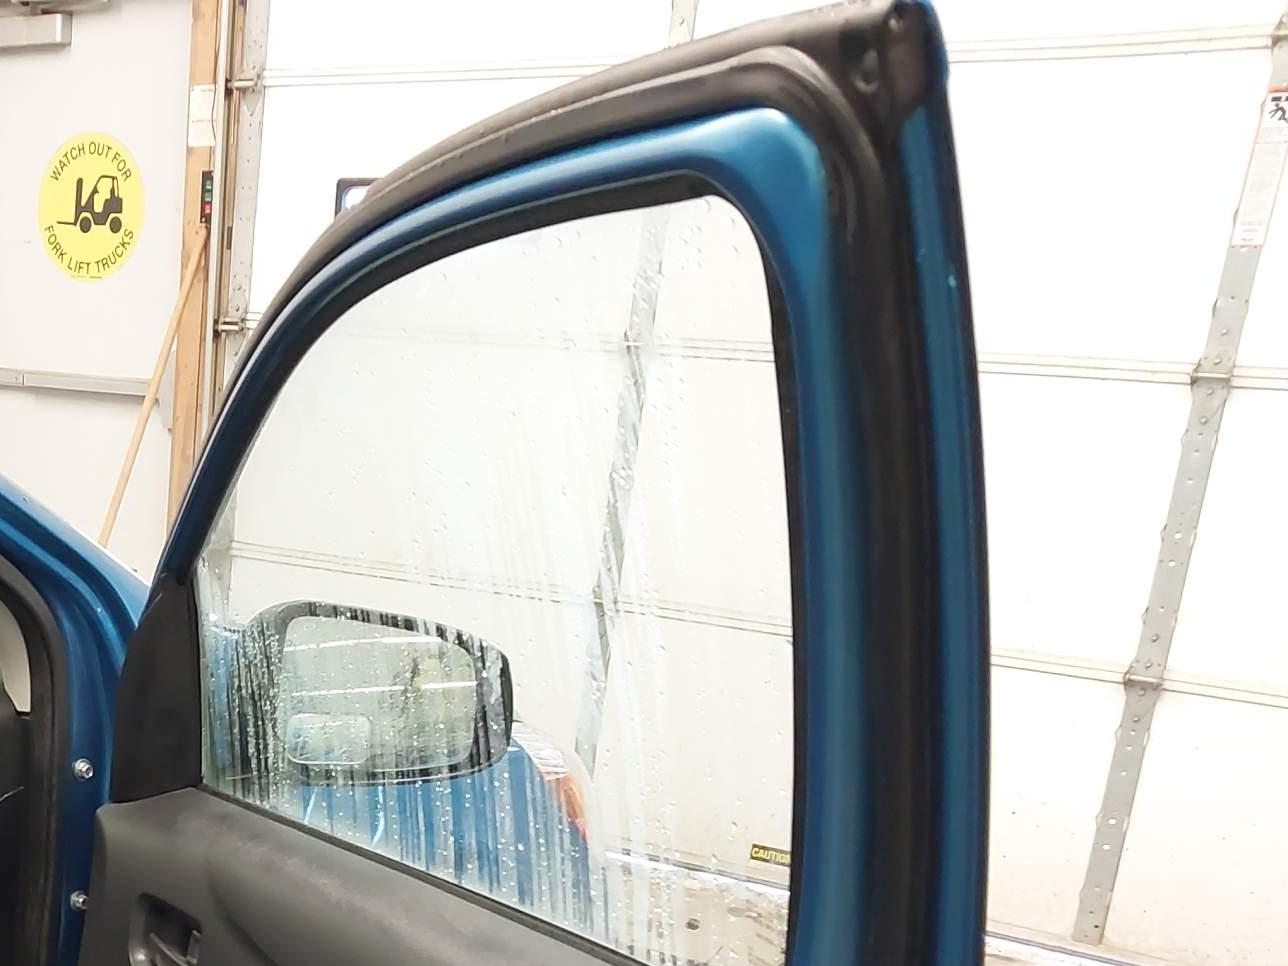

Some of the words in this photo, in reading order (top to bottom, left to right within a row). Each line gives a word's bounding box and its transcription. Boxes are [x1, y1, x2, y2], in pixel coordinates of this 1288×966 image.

[50, 143, 86, 182] WATCH
[88, 141, 113, 158] OUT
[111, 152, 132, 182] FOR
[44, 224, 68, 263] FORK
[67, 257, 92, 275] LIFT
[94, 228, 134, 273] TRUCKS
